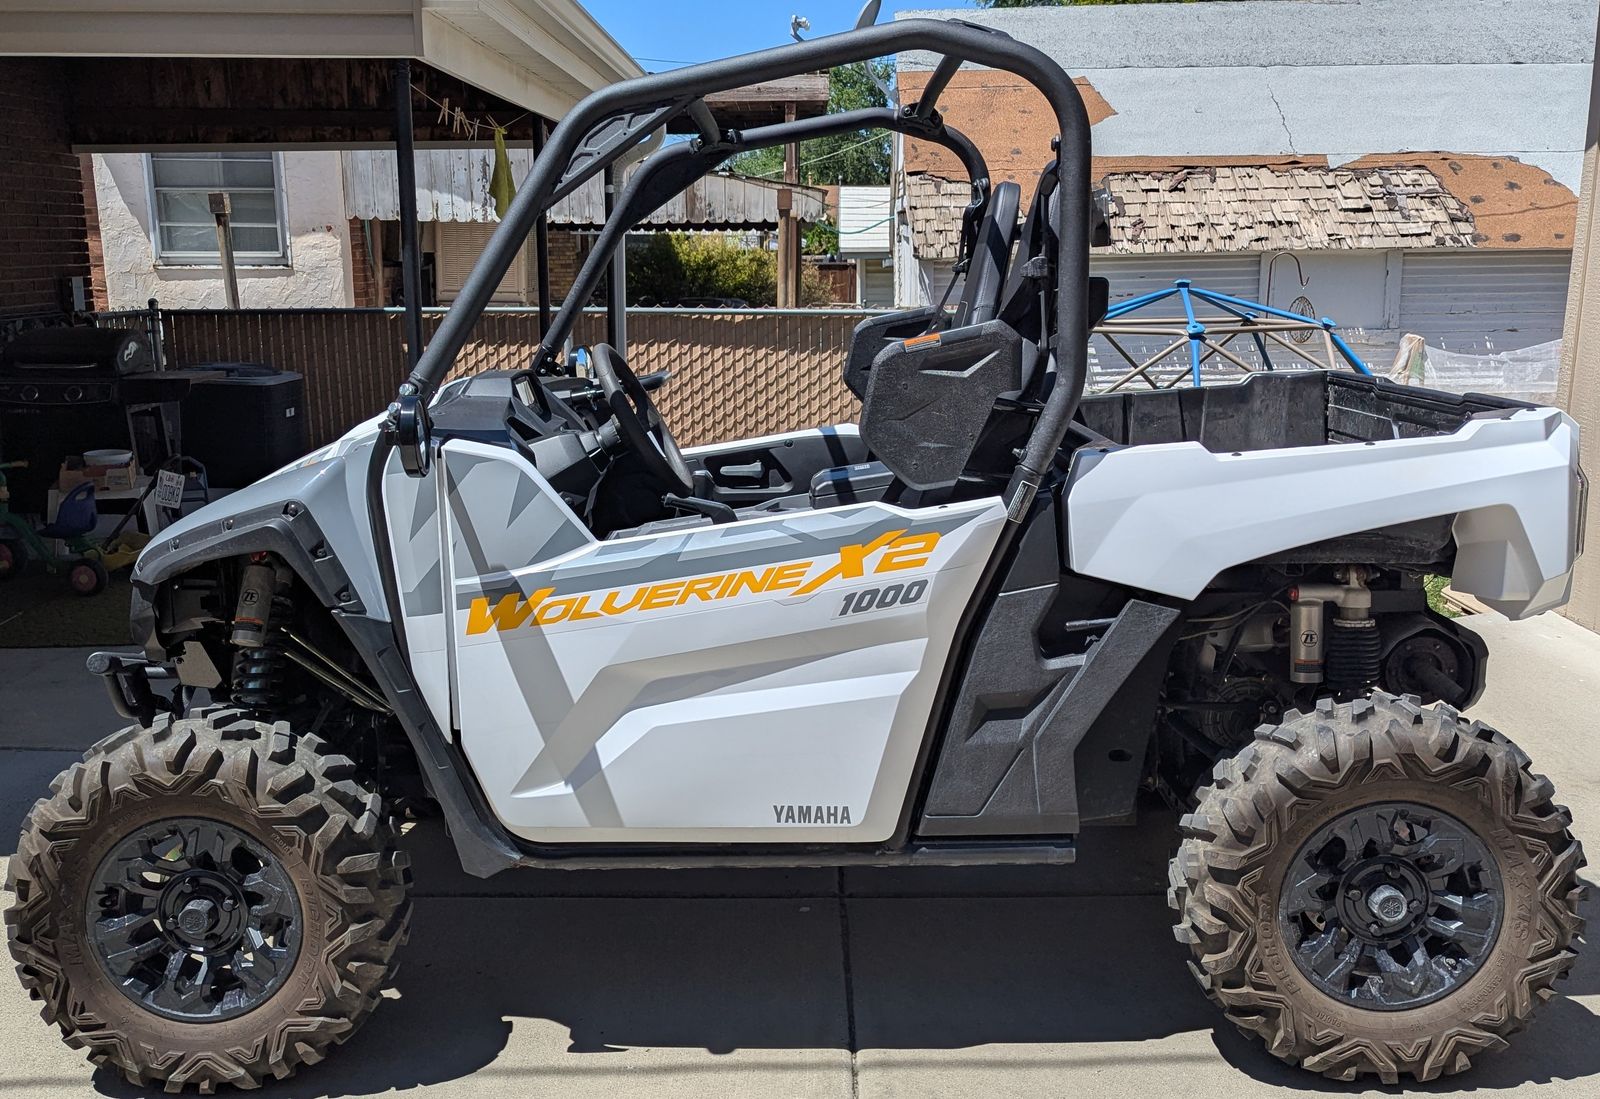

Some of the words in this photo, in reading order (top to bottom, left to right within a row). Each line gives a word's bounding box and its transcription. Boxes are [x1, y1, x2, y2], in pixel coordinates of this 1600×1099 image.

[465, 560, 813, 635] WOLVERINE
[790, 529, 942, 597] X2
[838, 579, 928, 616] 1000
[773, 805, 851, 824] YAMAHA
[1492, 828, 1532, 941] MAXXIS
